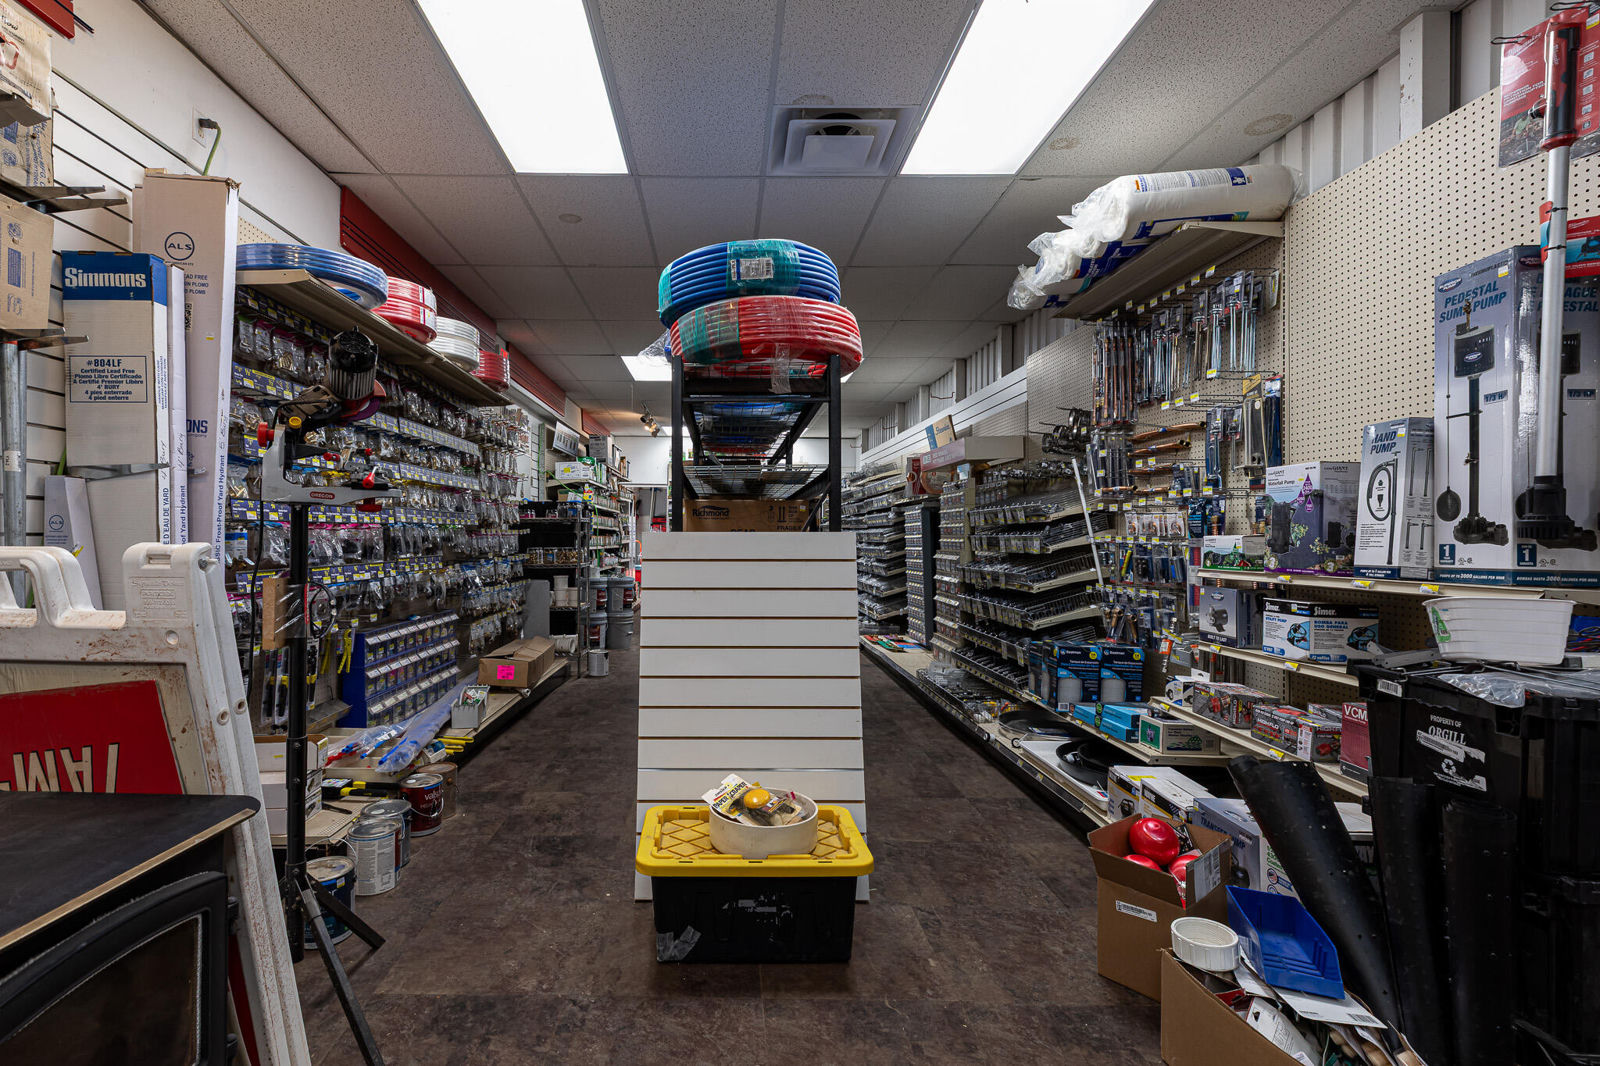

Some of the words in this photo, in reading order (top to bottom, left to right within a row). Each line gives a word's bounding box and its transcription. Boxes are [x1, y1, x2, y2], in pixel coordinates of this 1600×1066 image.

[64, 267, 147, 288] Simmons
[1444, 280, 1499, 308] PEDESTAL
[1439, 305, 1470, 323] SUM
[1472, 291, 1507, 312] PUMP
[1371, 431, 1397, 444] HAND
[1370, 442, 1397, 455] PUMP
[218, 455, 226, 484] Hydrant
[692, 508, 730, 517] Richmond
[1430, 714, 1455, 727] PROPERTY
[1454, 720, 1462, 728] OF
[1428, 725, 1467, 745] ORGILL
